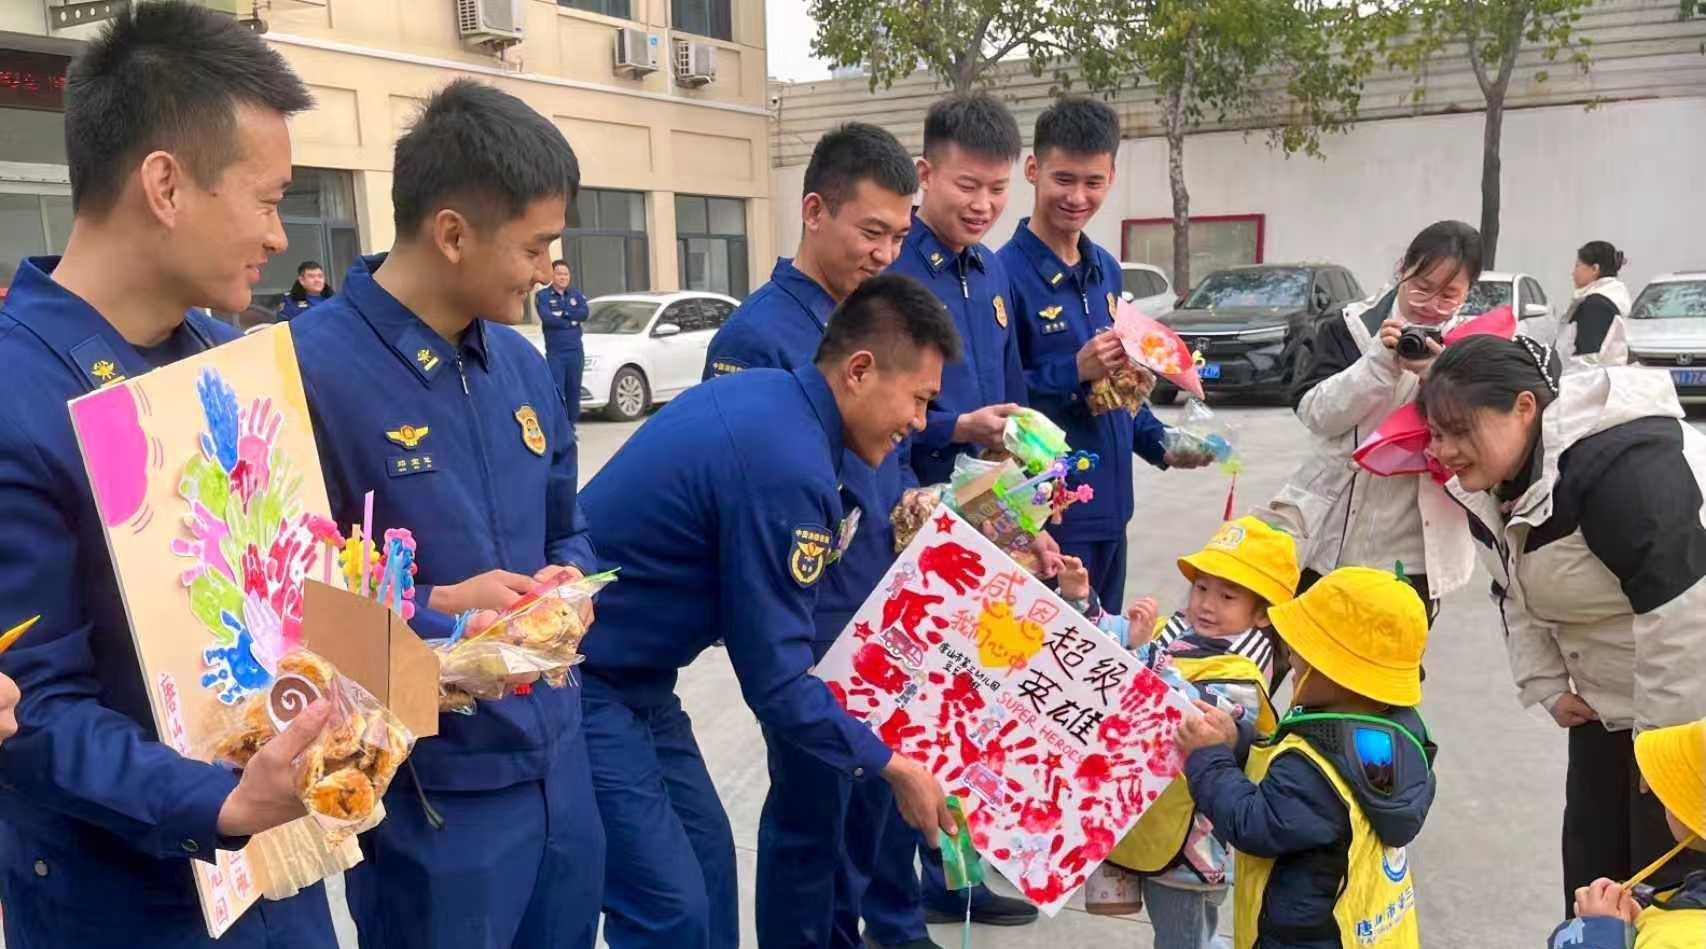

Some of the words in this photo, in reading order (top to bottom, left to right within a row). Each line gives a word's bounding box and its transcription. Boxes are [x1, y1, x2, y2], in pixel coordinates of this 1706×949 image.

[971, 571, 1060, 642] 感恩
[951, 609, 1028, 677] 我们心中
[1042, 626, 1128, 706] 超级
[997, 690, 1038, 730] SUPER
[1018, 668, 1104, 746] 英雄
